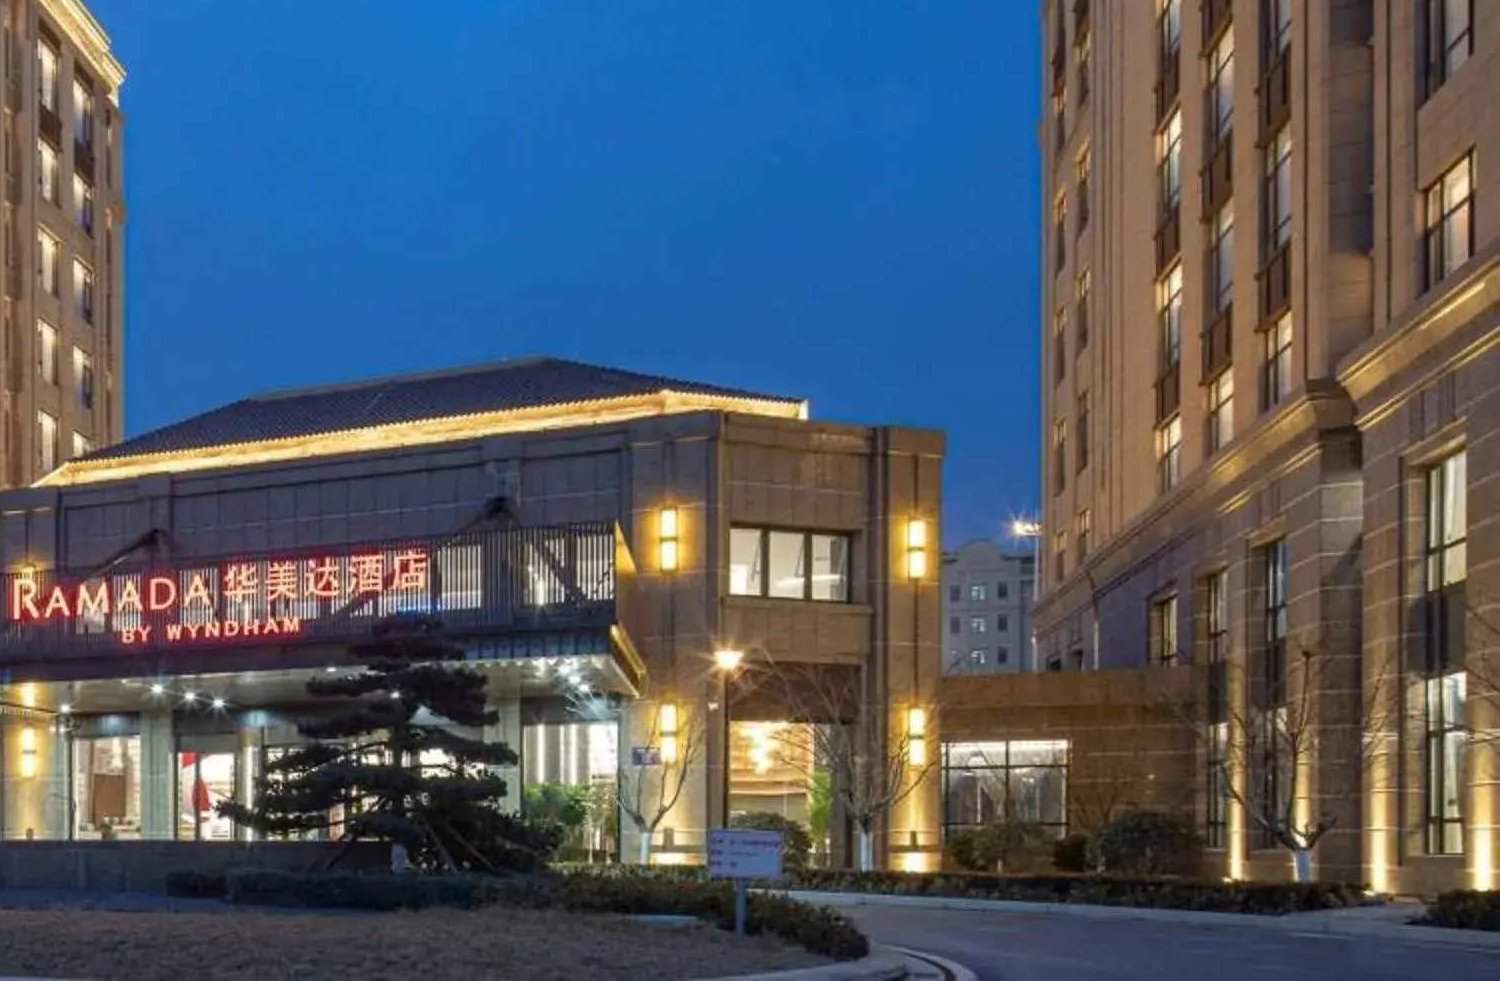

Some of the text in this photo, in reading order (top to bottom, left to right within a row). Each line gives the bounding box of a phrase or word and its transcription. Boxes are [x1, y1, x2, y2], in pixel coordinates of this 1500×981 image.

[13, 574, 212, 620] RAMADA
[223, 552, 427, 604] 华美达酒店
[121, 617, 301, 644] BY WYNDHAM
